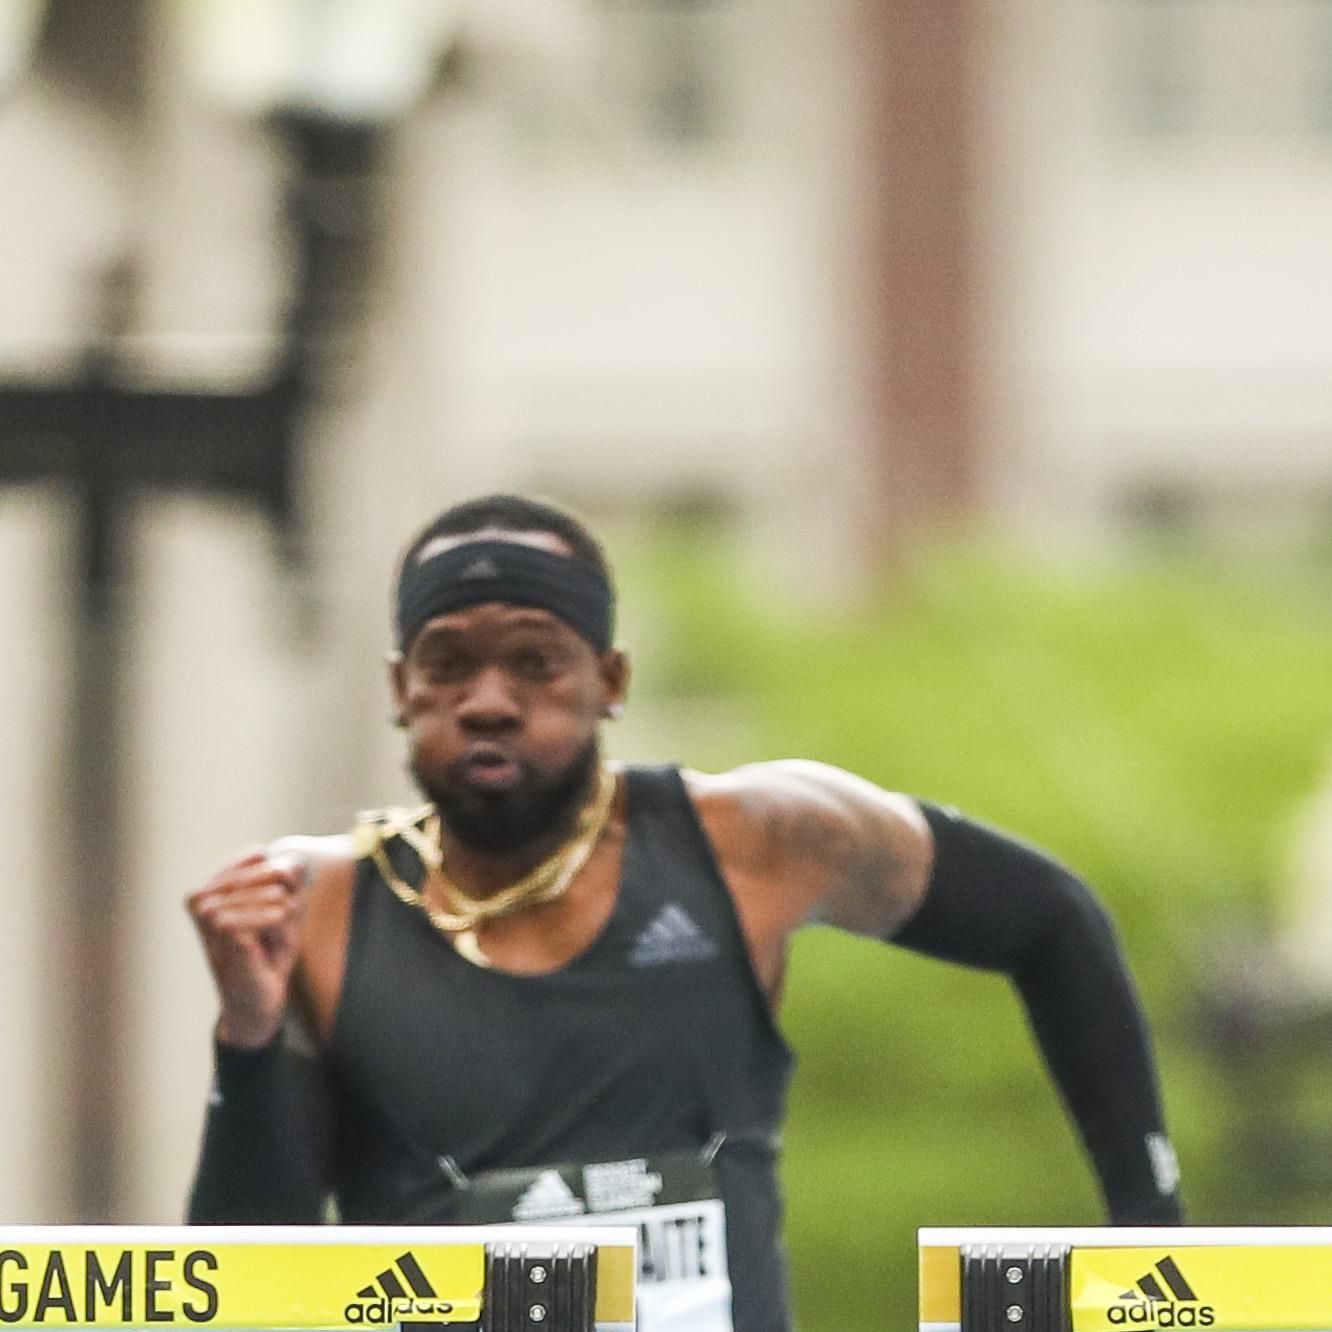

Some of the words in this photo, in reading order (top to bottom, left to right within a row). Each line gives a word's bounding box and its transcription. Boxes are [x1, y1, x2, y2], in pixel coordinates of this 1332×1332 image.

[0, 1249, 219, 1323] GAMES
[344, 1297, 453, 1324] adidas
[1107, 1300, 1215, 1328] adidas
